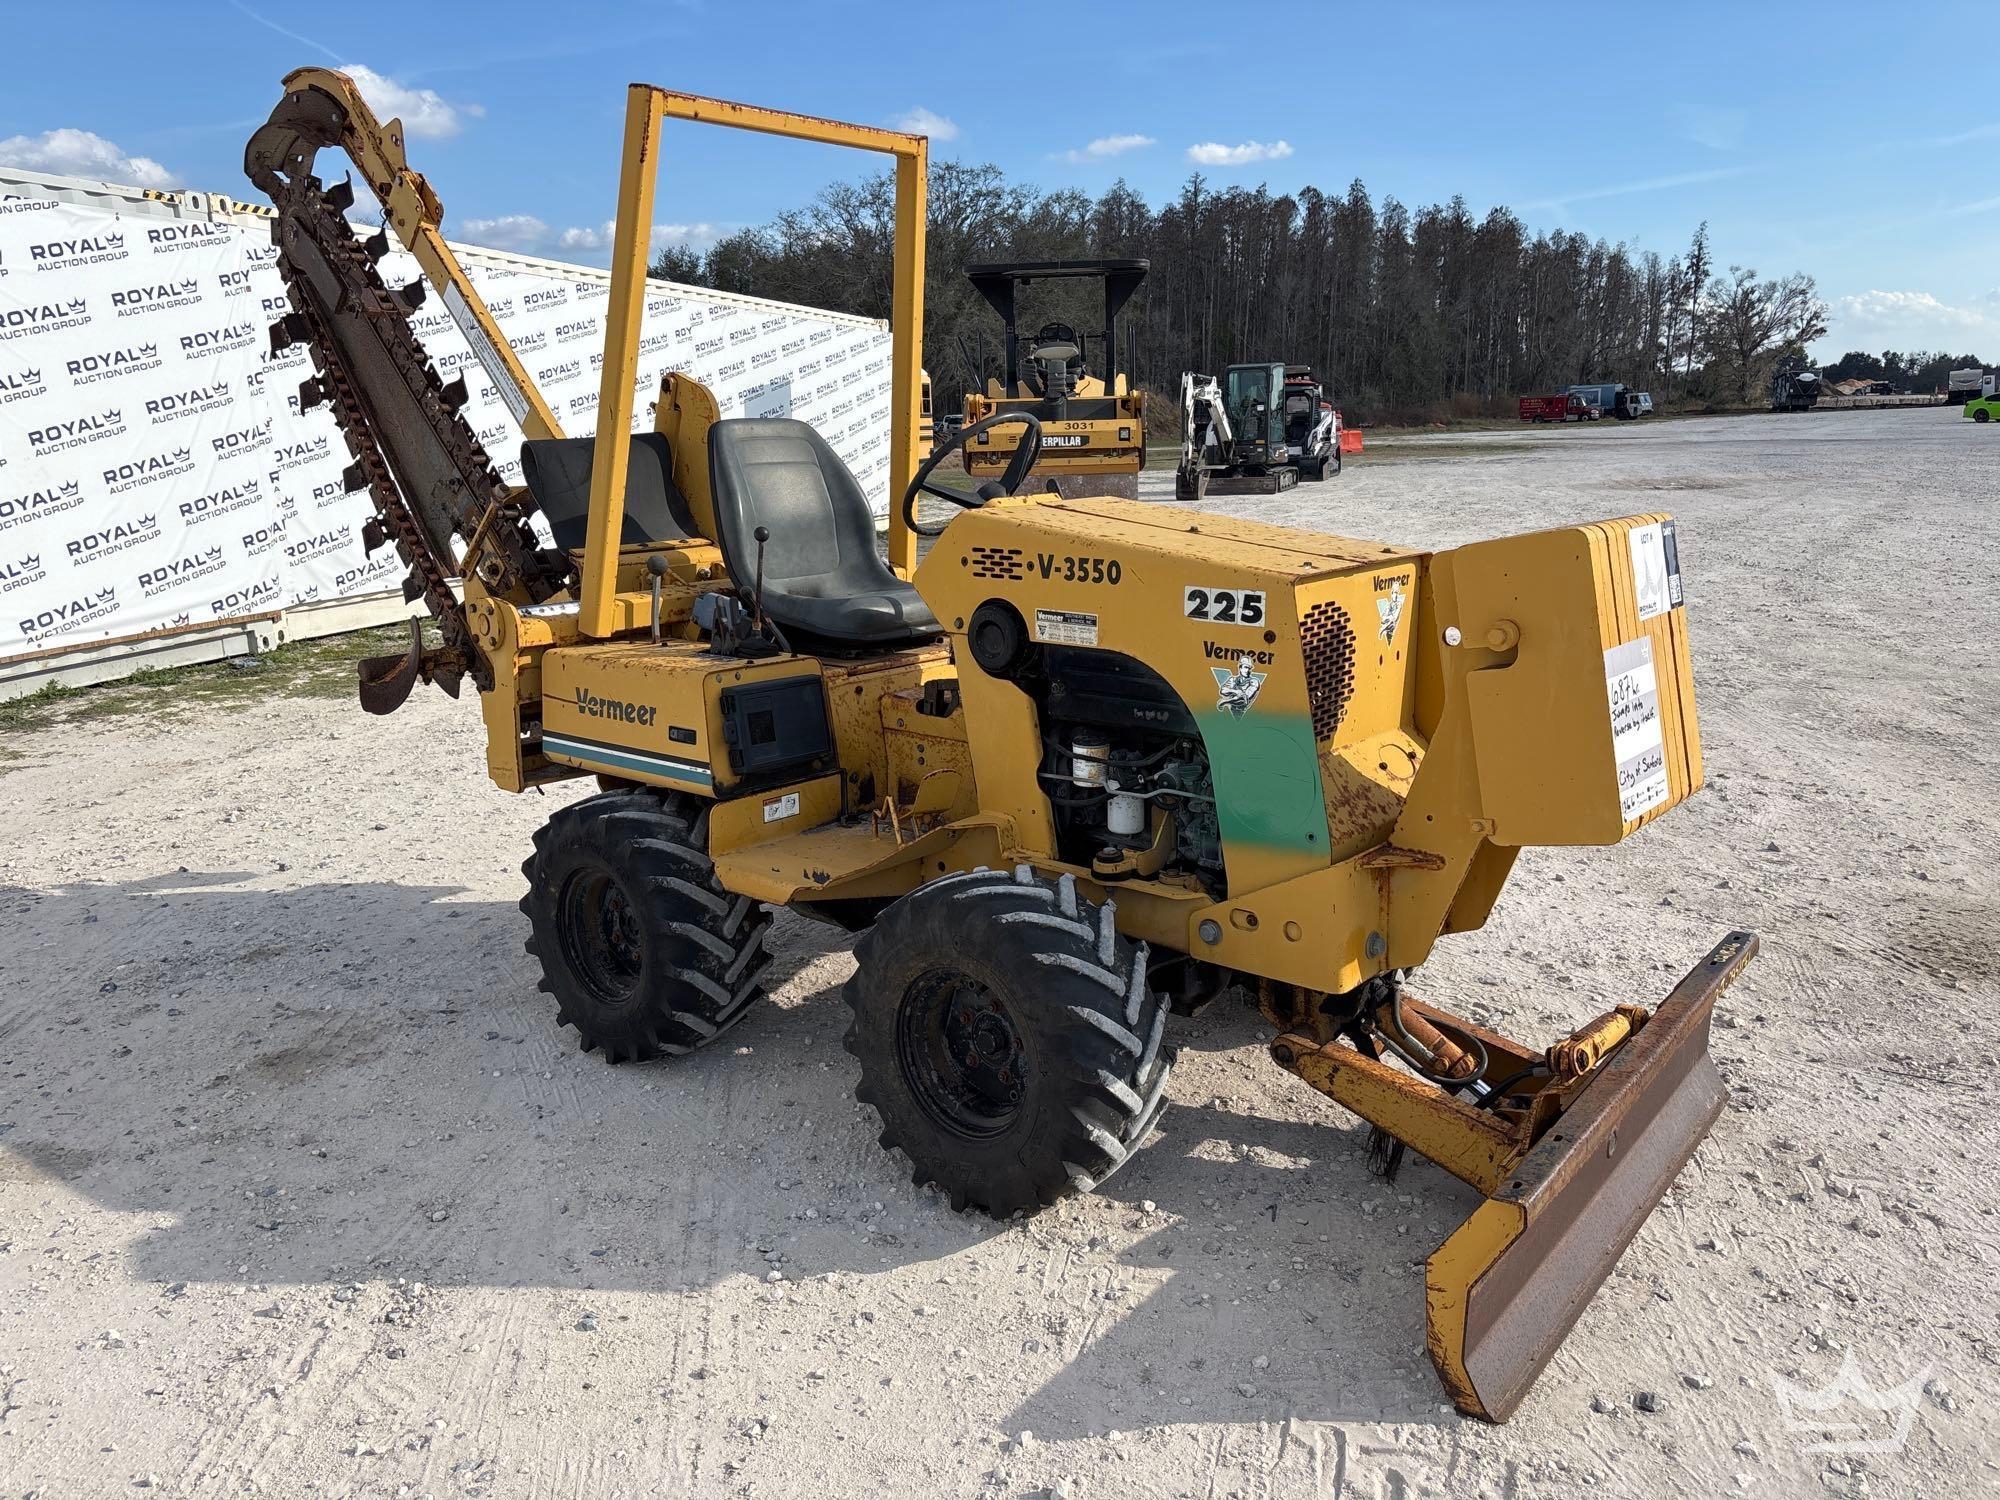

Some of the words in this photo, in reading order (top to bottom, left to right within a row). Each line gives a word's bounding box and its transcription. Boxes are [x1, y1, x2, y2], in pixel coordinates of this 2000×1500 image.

[14, 201, 60, 212] GROUP
[148, 222, 214, 244] ROYAL
[30, 236, 107, 260] ROYAL
[153, 241, 198, 254] AUCTION
[200, 236, 232, 248] GROUP
[37, 258, 88, 272] AUCTION
[90, 250, 129, 264] GROUP
[219, 270, 250, 288] ROY
[112, 282, 182, 308] ROYAL
[524, 290, 558, 306] ROYAL
[526, 302, 548, 312] AUCTION
[549, 298, 568, 309] GROUP
[648, 299, 675, 312] ROYAL
[118, 302, 165, 318] AUCTION
[166, 295, 202, 310] GROUP
[495, 311, 516, 321] GROUP
[52, 316, 92, 331] GROUP
[410, 314, 442, 331] OYAL
[431, 325, 454, 336] GROUP
[556, 320, 588, 337] ROYAL
[675, 326, 692, 338] ROY
[762, 318, 782, 330] ROYAL
[180, 325, 242, 350] ROYAL
[510, 334, 538, 350] OYAL
[558, 334, 580, 344] AUCTION
[580, 330, 598, 340] GROUP
[640, 336, 662, 349] OYAL
[695, 338, 718, 352] ROYAL
[730, 328, 751, 341] ROYAL
[66, 348, 141, 376] ROYAL
[186, 346, 229, 360] AUCTION
[751, 350, 772, 364] ROYAL
[72, 368, 122, 388] AUCTION
[124, 359, 163, 375] GROUP
[278, 358, 306, 370] GROUP
[539, 362, 571, 380] ROYAL
[719, 362, 740, 376] ROYAL
[5, 386, 48, 404] GROUP
[146, 387, 214, 416] ROYAL
[151, 406, 200, 426] AUCTION
[200, 397, 234, 412] GROUP
[28, 415, 104, 446] ROYAL
[1064, 422, 1094, 430] 3031
[34, 436, 88, 458] AUCTION
[88, 425, 127, 442] GROUP
[212, 424, 266, 452] ROYAL
[1042, 436, 1081, 447] ERPILLAR
[303, 450, 331, 466] GROUP
[498, 458, 520, 475] ROY
[103, 454, 175, 485] ROYAL
[110, 474, 158, 496] AUCTION
[159, 462, 196, 481] GROUP
[313, 480, 344, 500] ROY
[0, 488, 60, 518] OYAL
[44, 496, 84, 516] GROUP
[179, 487, 244, 518] ROYAL
[186, 508, 229, 528] AUCTION
[230, 494, 263, 511] GROUP
[67, 522, 140, 557] ROYAL
[73, 545, 123, 567] AUCTION
[124, 530, 162, 548] GROUP
[290, 548, 325, 568] AUCTION
[326, 538, 354, 554] GROUP
[138, 552, 207, 590] ROYAL
[144, 576, 190, 598] AUCTION
[192, 560, 228, 580] GROUP
[335, 559, 386, 587] ROYAL
[1038, 553, 1122, 585] V-3550
[4, 570, 47, 593] GROUP
[339, 577, 372, 596] AUCTION
[373, 564, 399, 582] GROUP
[212, 578, 274, 614] ROYAL
[1186, 589, 1263, 624] 225
[19, 596, 98, 636] ROYAL
[82, 602, 121, 623] GROUP
[1038, 612, 1064, 622] Vermeer
[1203, 640, 1275, 666] Vermeer
[575, 686, 657, 727] Vermeer
[1619, 769, 1636, 788] City
